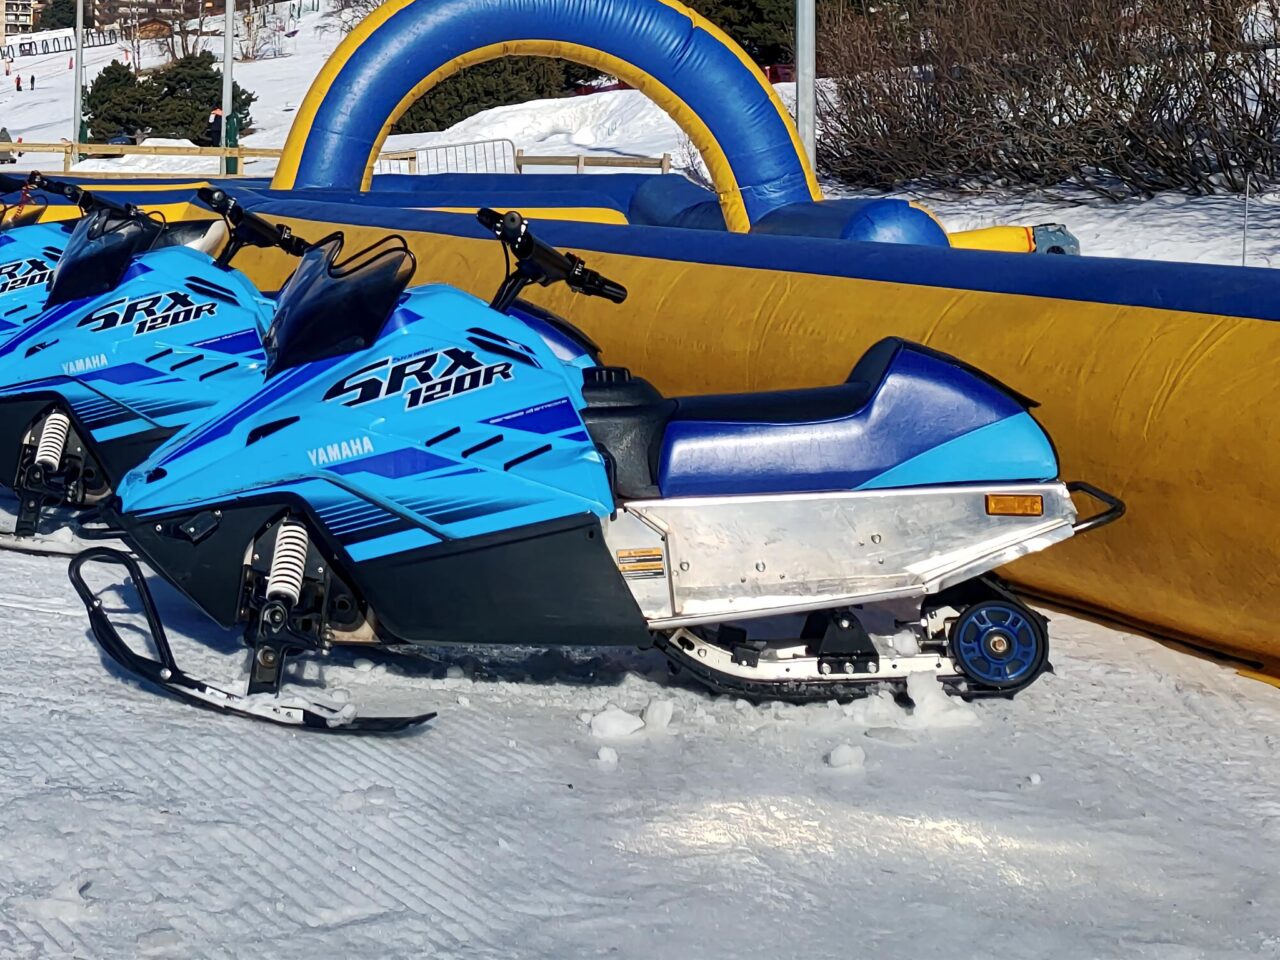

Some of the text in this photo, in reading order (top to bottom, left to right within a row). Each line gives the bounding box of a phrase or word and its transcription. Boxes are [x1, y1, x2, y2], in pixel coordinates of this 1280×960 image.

[76, 291, 197, 332] SRX
[134, 302, 218, 336] 120R
[61, 353, 109, 376] YAMAHA
[321, 347, 485, 407] SRX
[404, 361, 515, 411] 120R
[308, 436, 374, 466] YAMAHA
